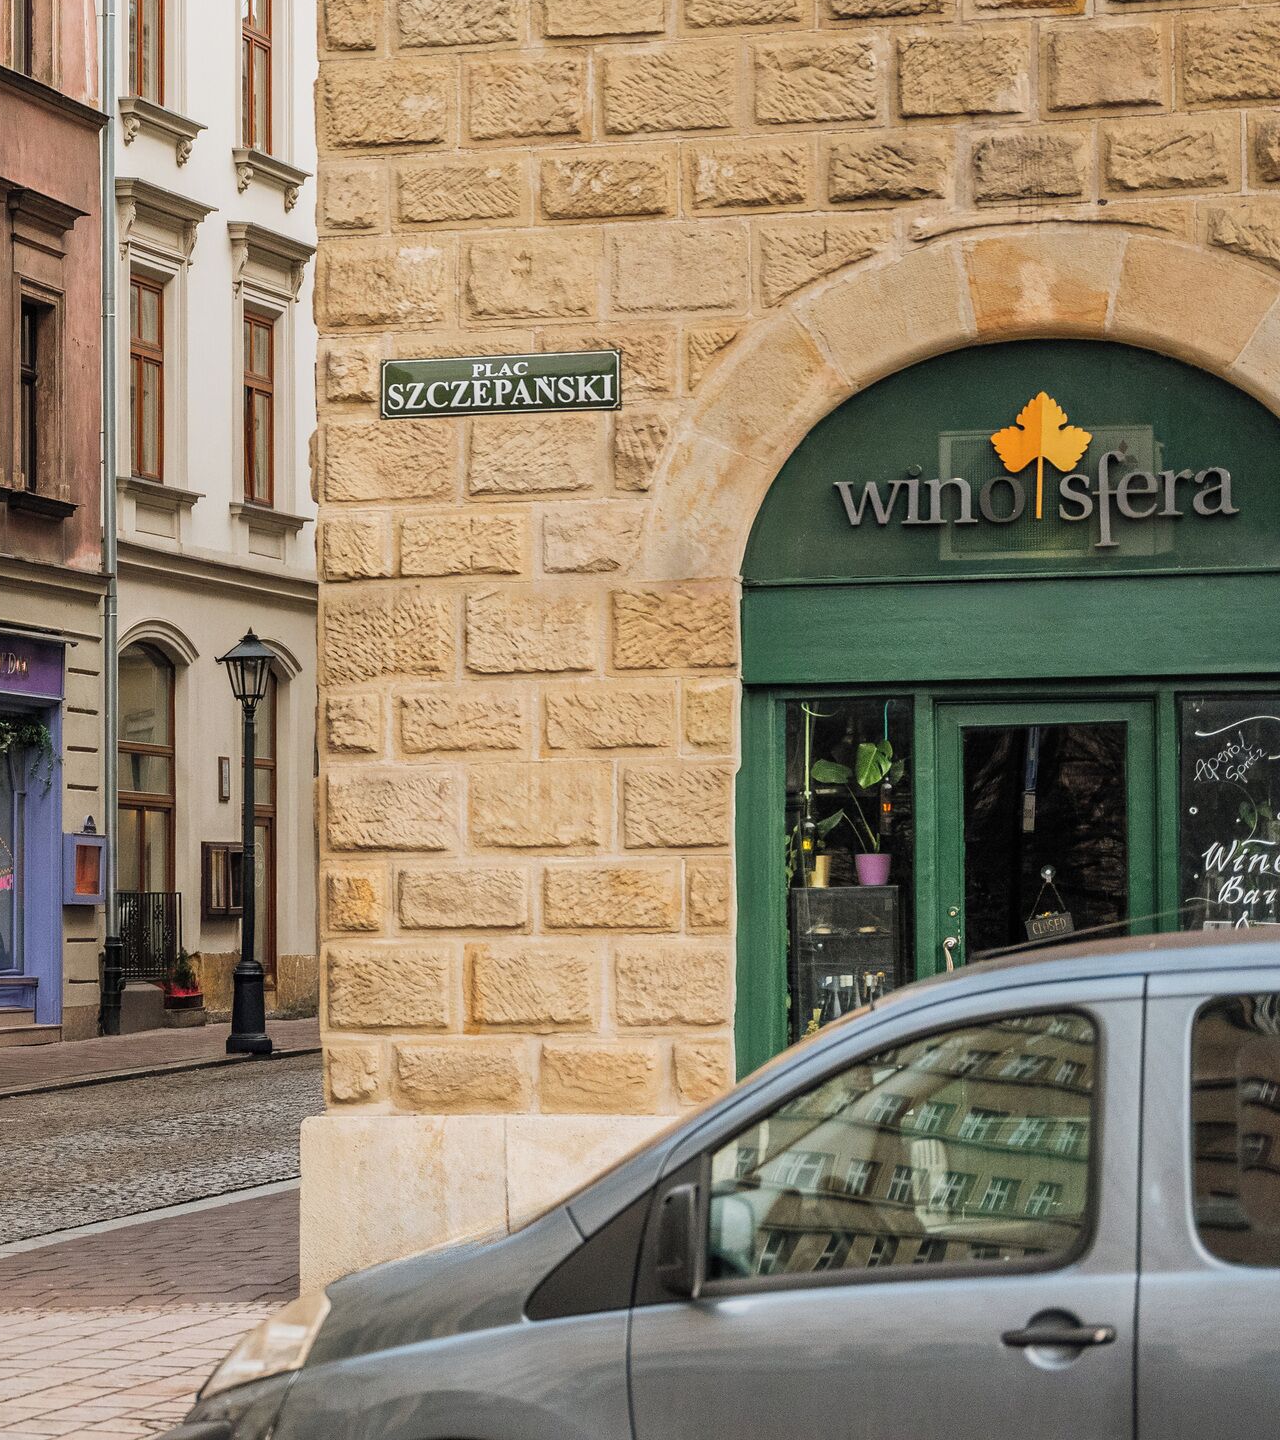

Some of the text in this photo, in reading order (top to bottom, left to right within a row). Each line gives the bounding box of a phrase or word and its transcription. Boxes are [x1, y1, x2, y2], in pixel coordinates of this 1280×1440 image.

[471, 361, 529, 378] PLAC
[387, 374, 615, 410] SZCZEPAŃSKI
[1217, 875, 1278, 905] Bar
[1032, 917, 1067, 935] CLOSED
